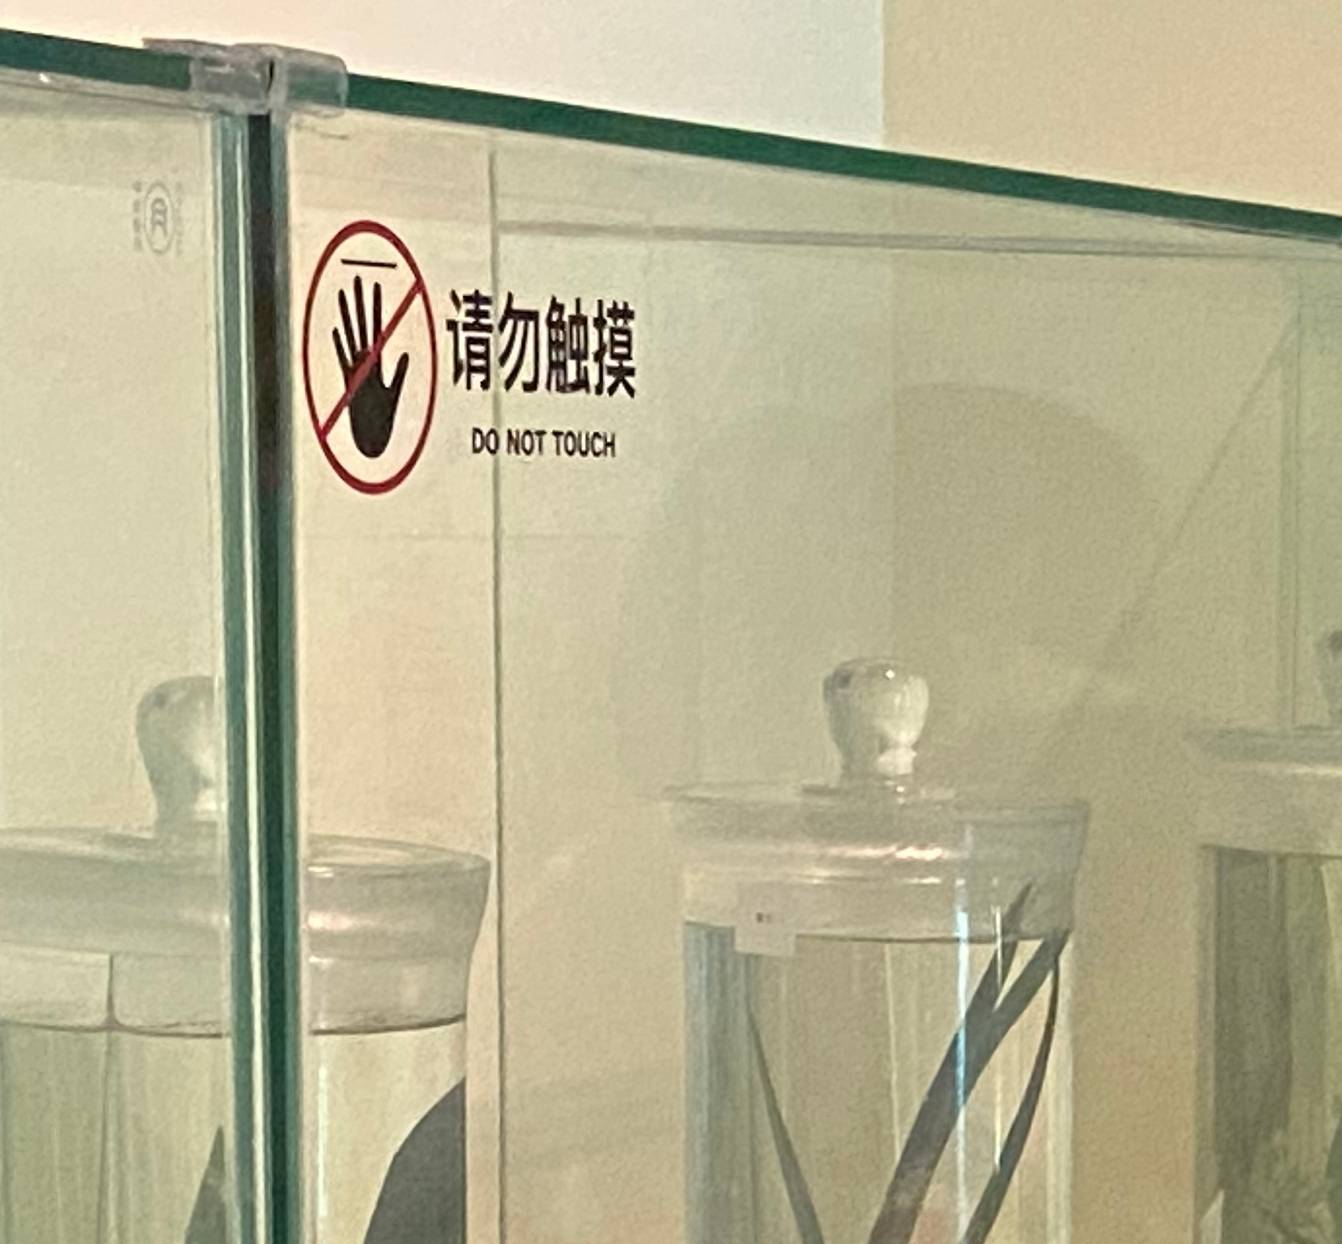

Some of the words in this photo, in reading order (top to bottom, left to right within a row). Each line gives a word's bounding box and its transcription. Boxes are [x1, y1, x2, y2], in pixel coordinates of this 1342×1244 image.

[446, 289, 636, 399] 请勿触摸
[472, 427, 500, 455] DO
[507, 428, 547, 456] NOT
[552, 430, 616, 458] TOUCH
